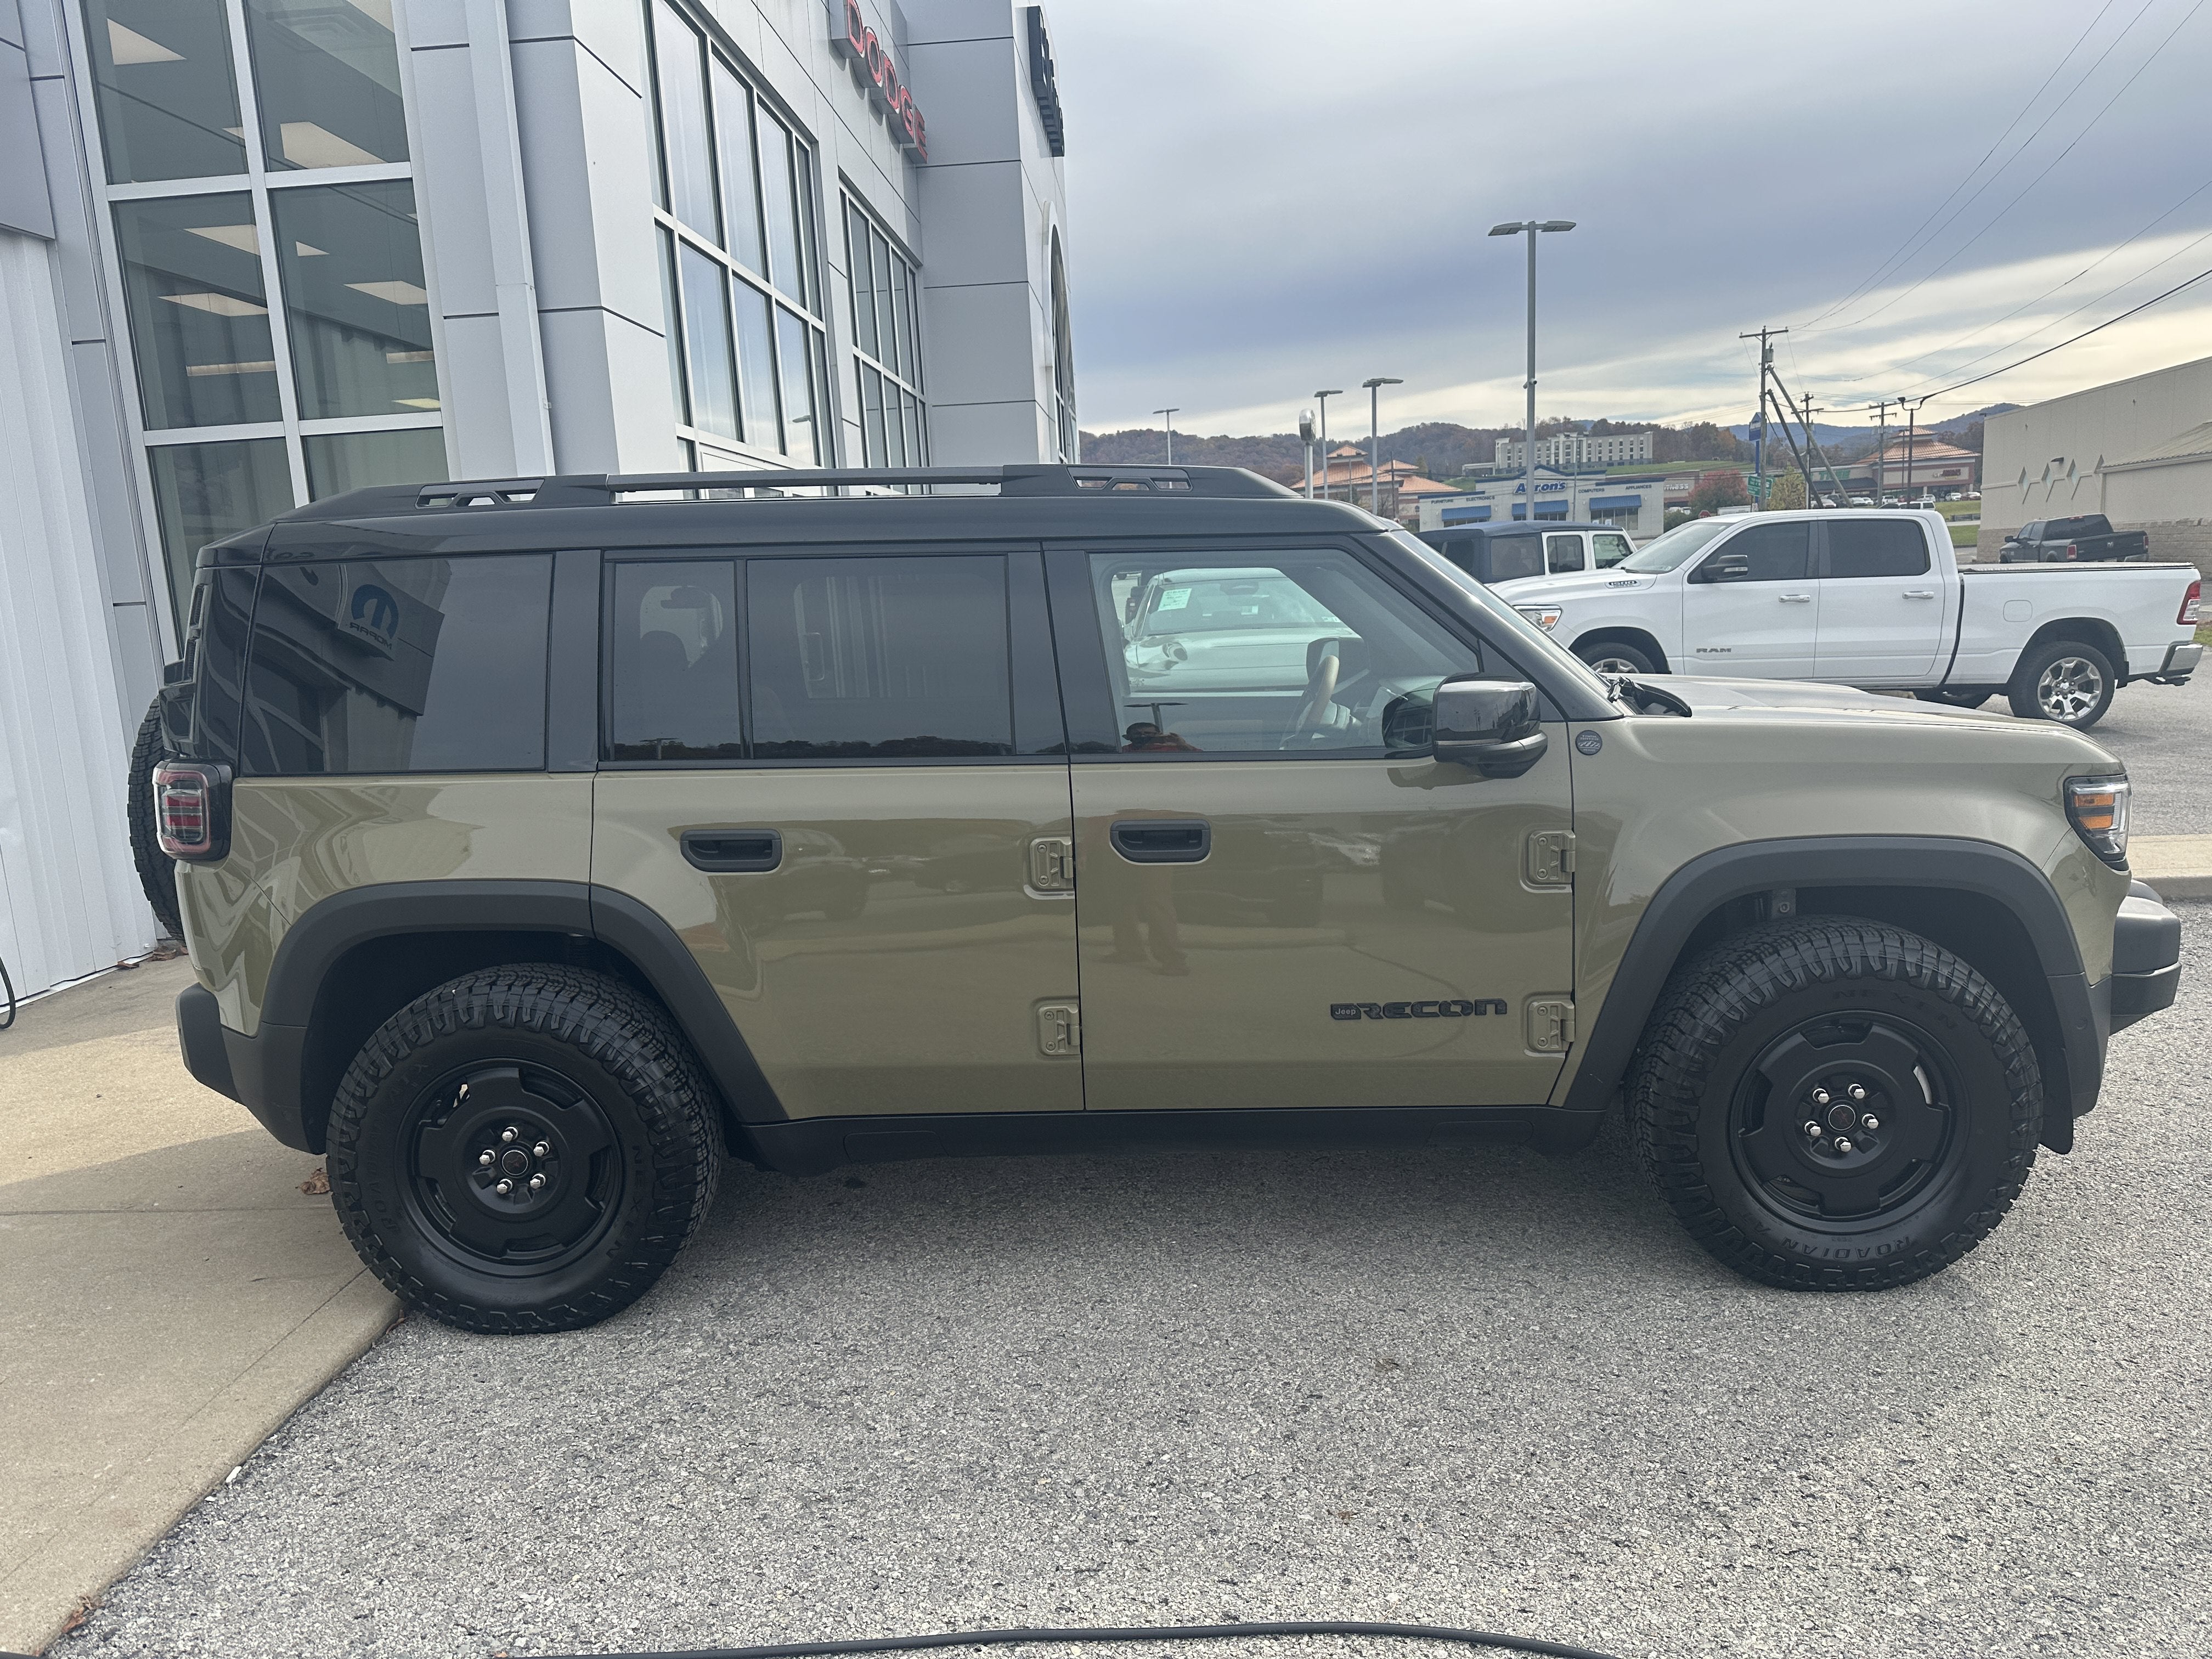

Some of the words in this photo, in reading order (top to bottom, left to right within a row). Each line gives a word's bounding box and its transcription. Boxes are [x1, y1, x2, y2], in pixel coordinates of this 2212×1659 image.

[846, 0, 928, 164] DODGE
[1514, 480, 1566, 494] Aron's
[1335, 1007, 1357, 1017] Jeep
[1357, 998, 1507, 1019] RECON
[606, 1145, 644, 1260] NEXEN
[1780, 1235, 1912, 1261] ROADIAN
